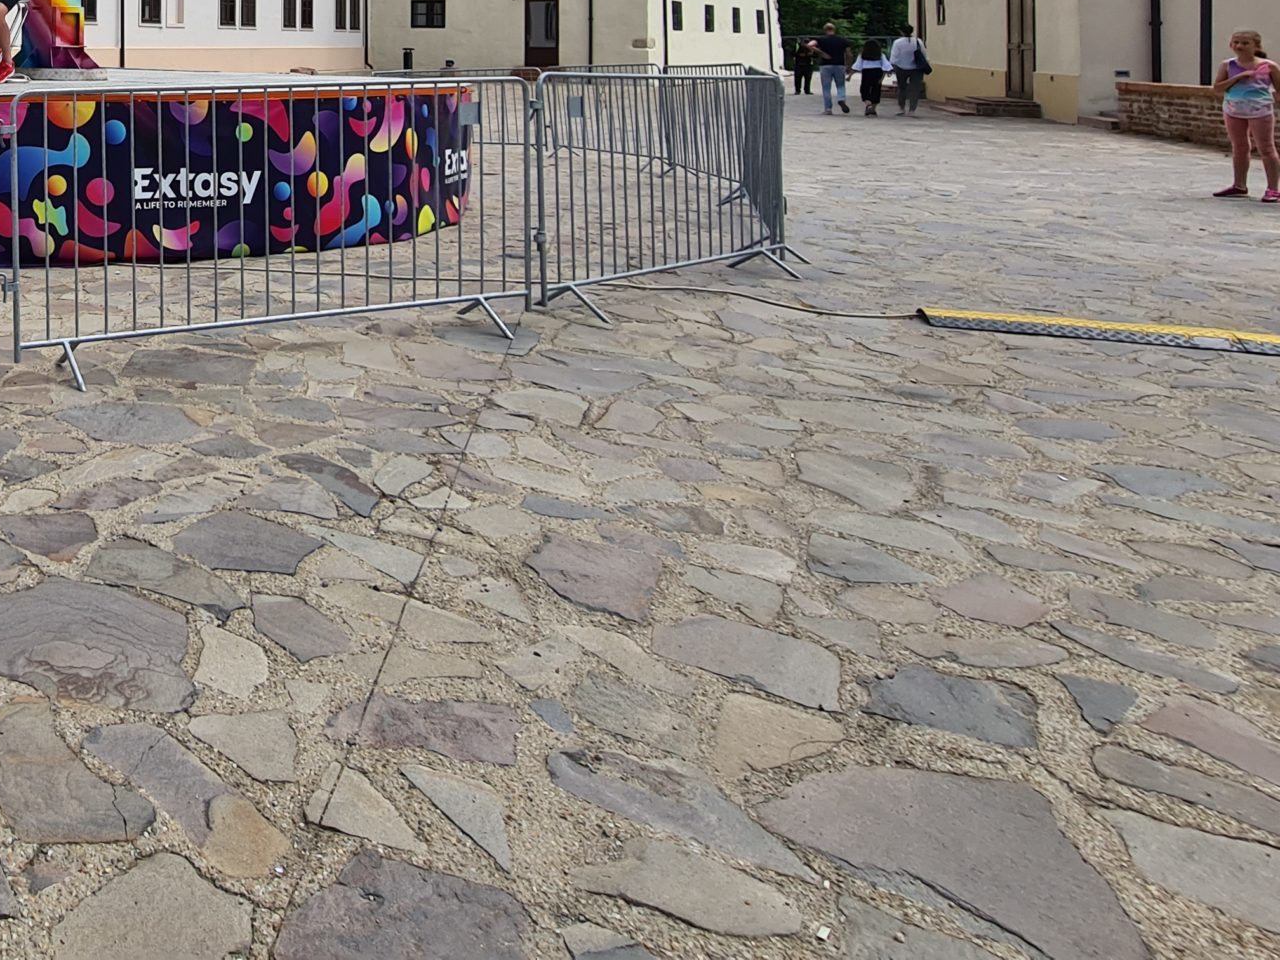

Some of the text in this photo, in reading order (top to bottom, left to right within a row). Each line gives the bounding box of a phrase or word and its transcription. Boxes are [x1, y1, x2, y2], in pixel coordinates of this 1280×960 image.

[133, 167, 262, 204] Extasy
[135, 202, 142, 210] A
[143, 201, 161, 210] LIFE
[164, 201, 176, 209] TO
